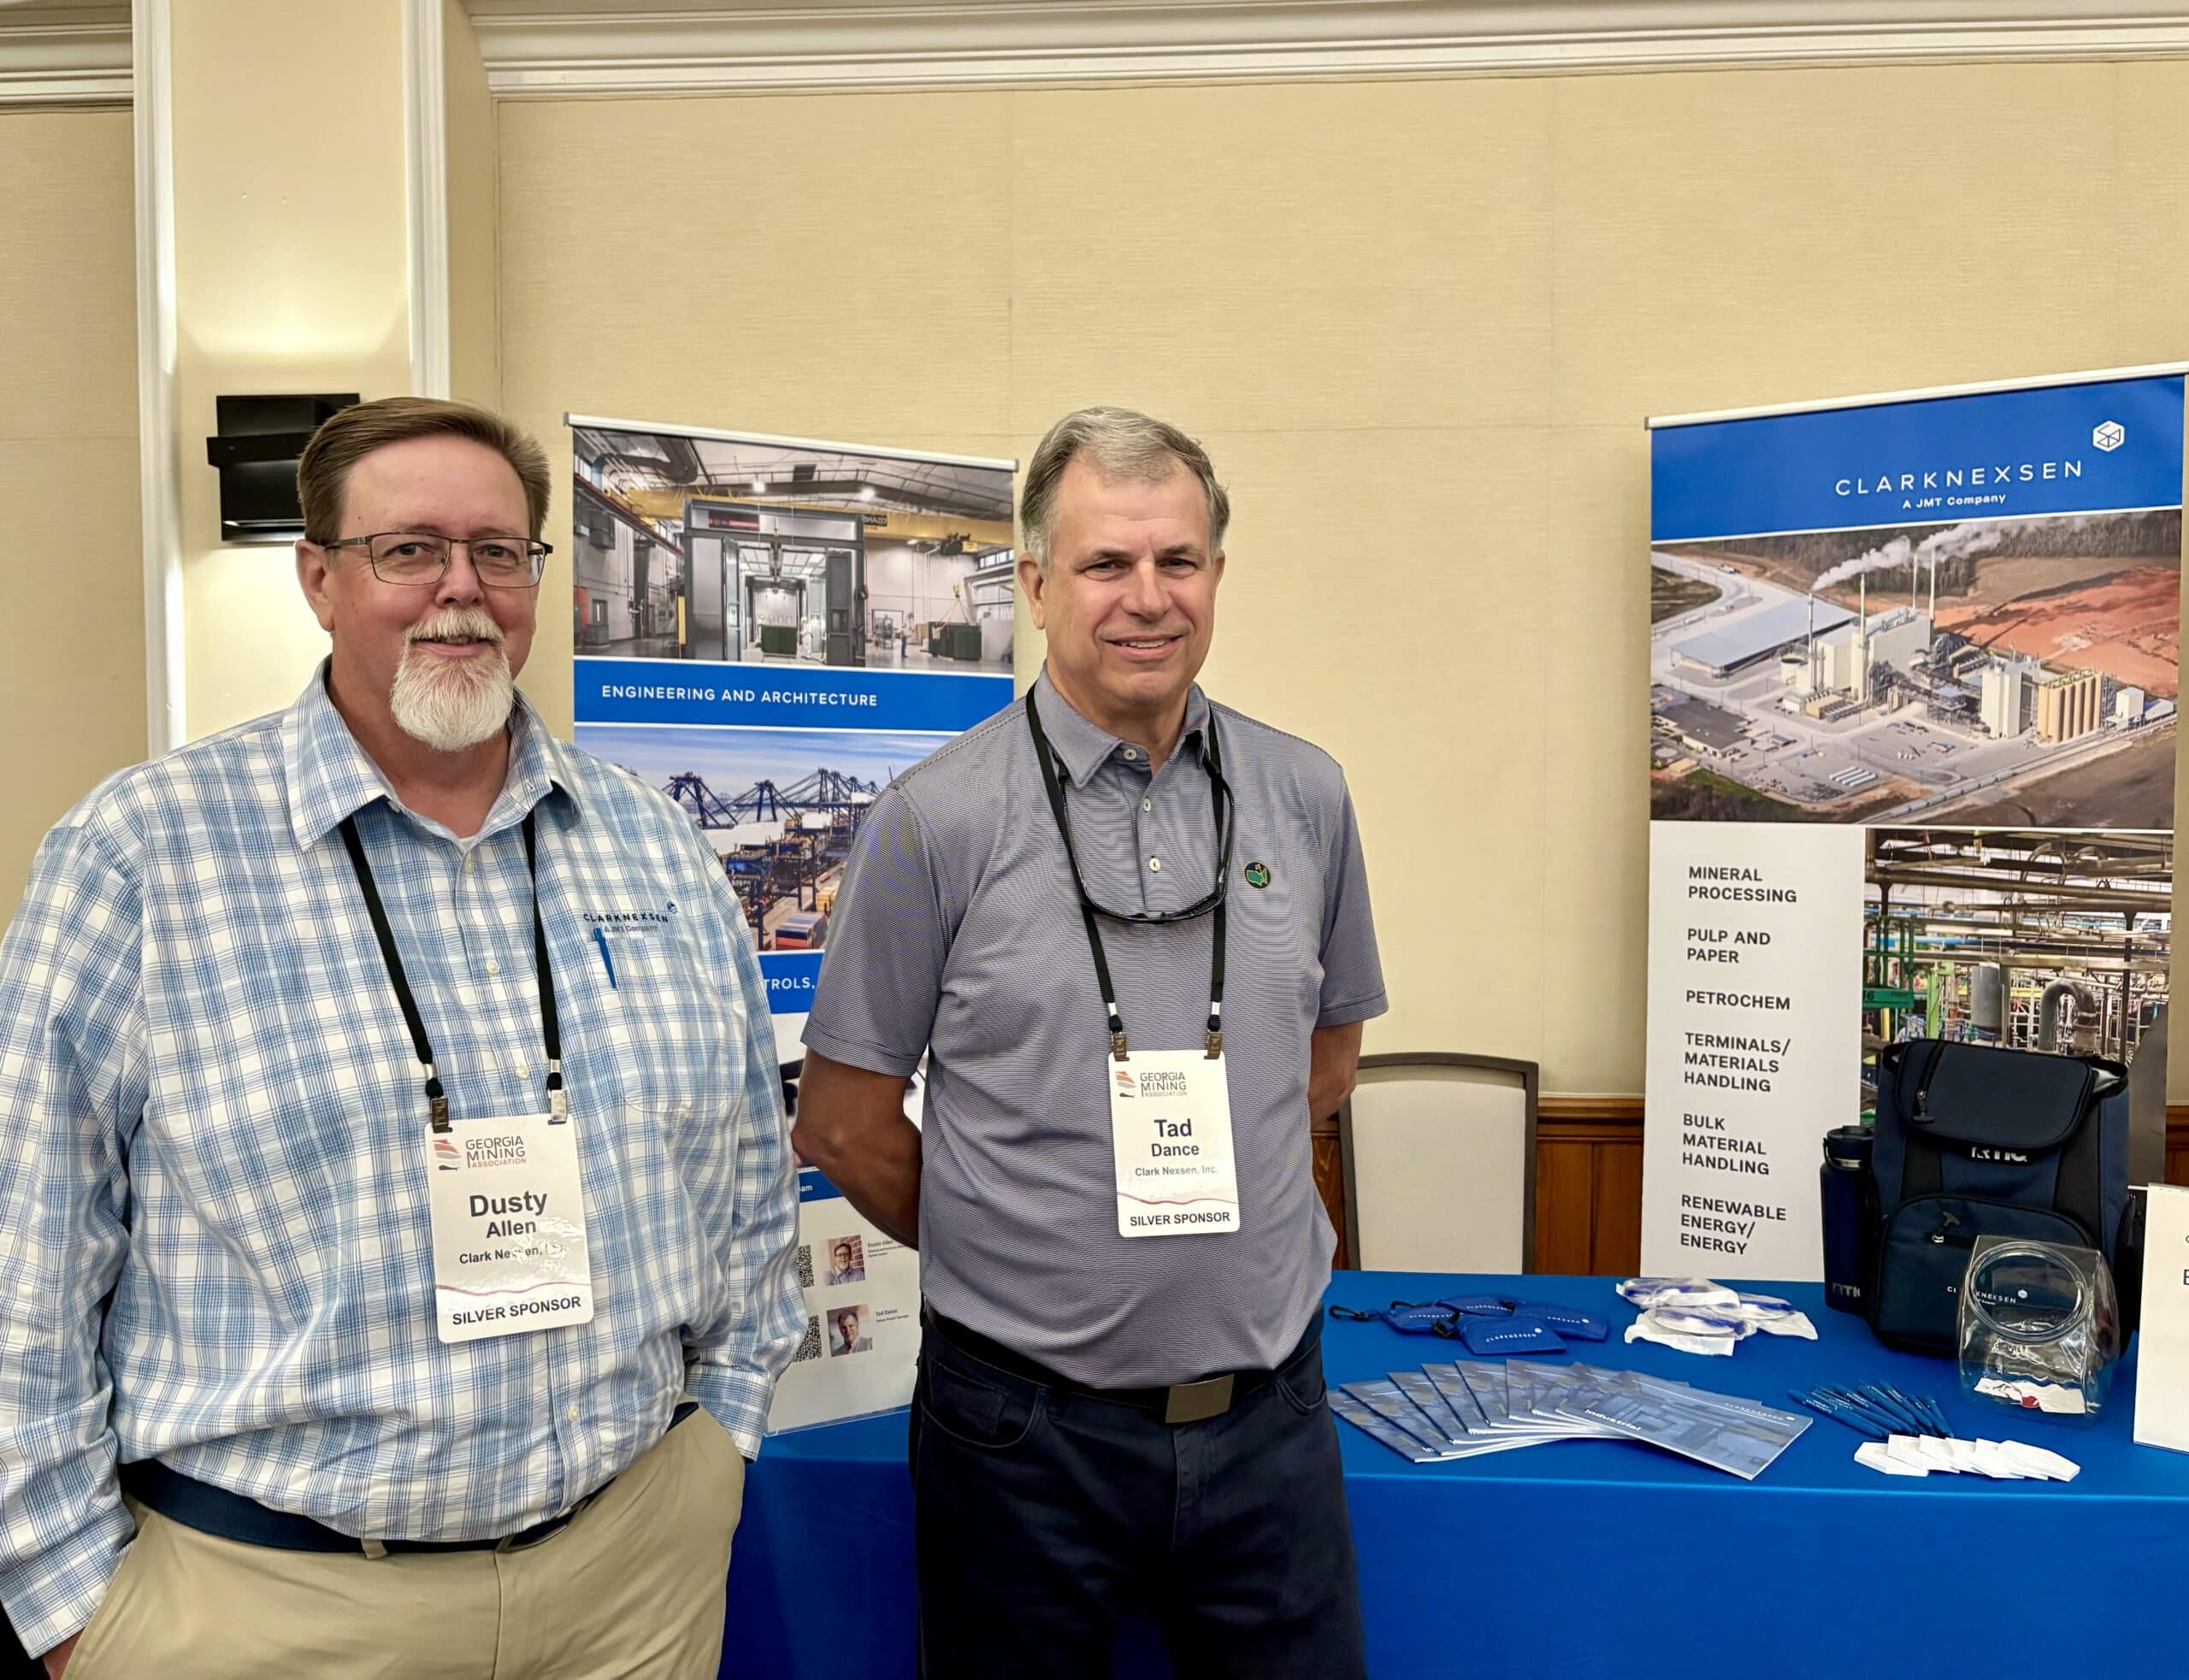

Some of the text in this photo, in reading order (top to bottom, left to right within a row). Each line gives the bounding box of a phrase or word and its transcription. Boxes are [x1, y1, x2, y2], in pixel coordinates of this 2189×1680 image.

[1834, 460, 2082, 496] CLARKNEXSEN
[1902, 494, 2006, 510] A JMT Company
[601, 685, 878, 707] ENGINEERING AND ARCHITECTURE
[1688, 866, 1763, 881] MINERAL
[1688, 886, 1797, 903] PROCESSING
[583, 913, 669, 923] CLARKNEXSEN
[1687, 928, 1771, 945] PULP AND
[1687, 948, 1739, 964] PAPER
[1686, 990, 1791, 1011] PETROCHEM
[1685, 1032, 1791, 1056] TERMINALS/
[1685, 1052, 1779, 1073] MATERIALS
[1140, 1071, 1186, 1083] GEORGIA
[1684, 1071, 1771, 1092] HANDLING
[1141, 1082, 1187, 1095] MINING
[1154, 1118, 1192, 1138] Tad
[1683, 1113, 1726, 1131] BULK
[465, 1135, 524, 1153] GEORGIA
[1151, 1142, 1200, 1157] Dance
[1683, 1133, 1767, 1155] MATERIAL
[466, 1147, 526, 1165] MINING
[472, 1158, 527, 1169] ASSOCIATION
[1682, 1152, 1770, 1176] HANDLING
[1135, 1165, 1218, 1176] Clark Nexsen, Inc.
[469, 1190, 548, 1217] Dusty
[1681, 1194, 1786, 1221] RENEWABLE
[1130, 1211, 1230, 1227] SILVER SPONSOR
[1680, 1213, 1756, 1239] ENERGY/
[486, 1219, 537, 1239] Allen
[1680, 1233, 1748, 1255] ENERGY
[459, 1252, 492, 1264] Clark
[494, 1247, 543, 1260] Neen,
[452, 1295, 581, 1325] SILVER SPONSOR
